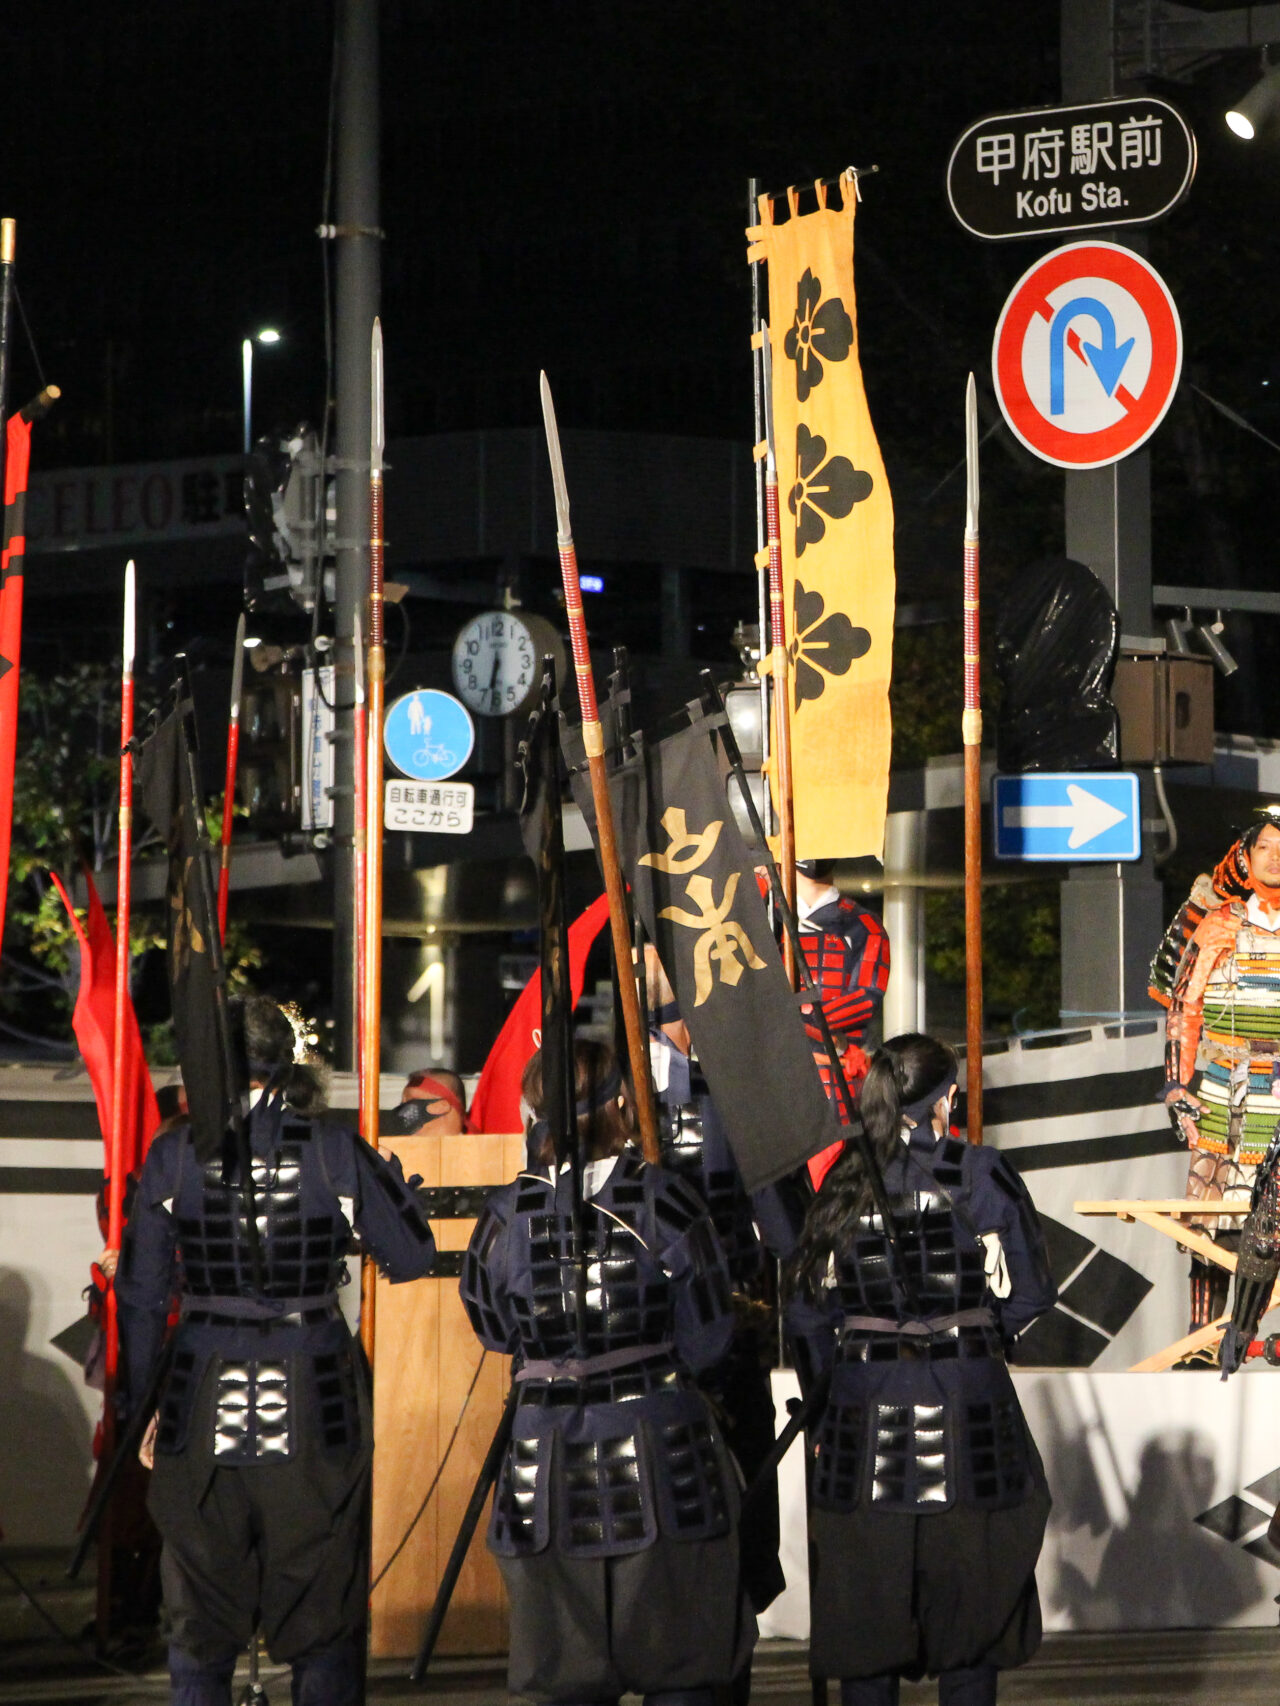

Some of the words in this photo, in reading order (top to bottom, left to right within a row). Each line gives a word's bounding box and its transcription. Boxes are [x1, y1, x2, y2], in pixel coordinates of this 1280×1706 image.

[976, 115, 1163, 186] 甲府駅前
[1016, 188, 1072, 219] Kofu
[1081, 181, 1129, 212] Sta.
[491, 620, 504, 637] 12
[465, 640, 480, 656] 10
[518, 636, 527, 652] 2
[463, 658, 473, 674] 9
[520, 654, 531, 670] 3
[467, 674, 477, 690] 8
[517, 672, 526, 686] 4
[479, 688, 488, 704] 7
[506, 686, 516, 702] 5
[390, 787, 467, 809] 自転車通行可
[394, 808, 461, 828] ここから
[407, 962, 445, 1060] 1
